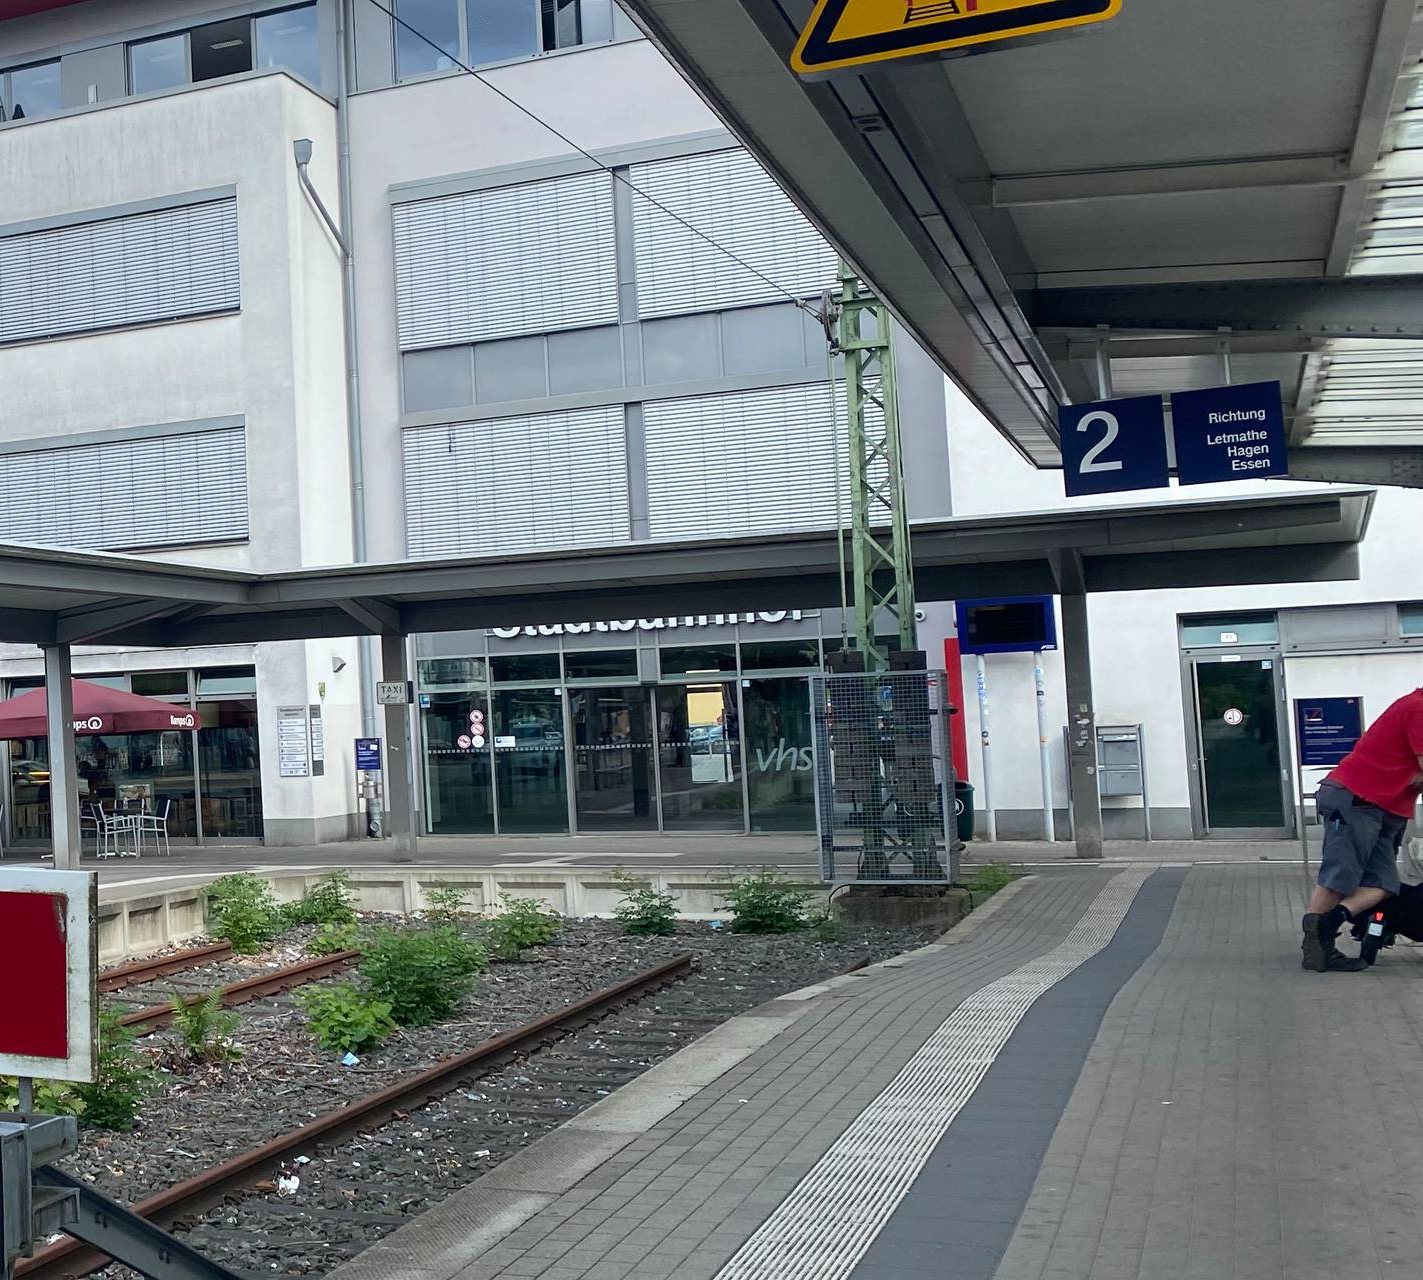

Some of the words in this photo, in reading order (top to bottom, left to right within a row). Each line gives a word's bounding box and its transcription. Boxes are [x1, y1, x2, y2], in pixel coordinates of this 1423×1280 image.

[1208, 408, 1266, 425] Richtung
[1077, 411, 1122, 474] 2
[1207, 429, 1267, 445] Letmathe
[1227, 444, 1269, 458] Hagen
[1231, 458, 1271, 471] Essen
[381, 685, 402, 694] TAXI
[756, 738, 812, 771] vhs
